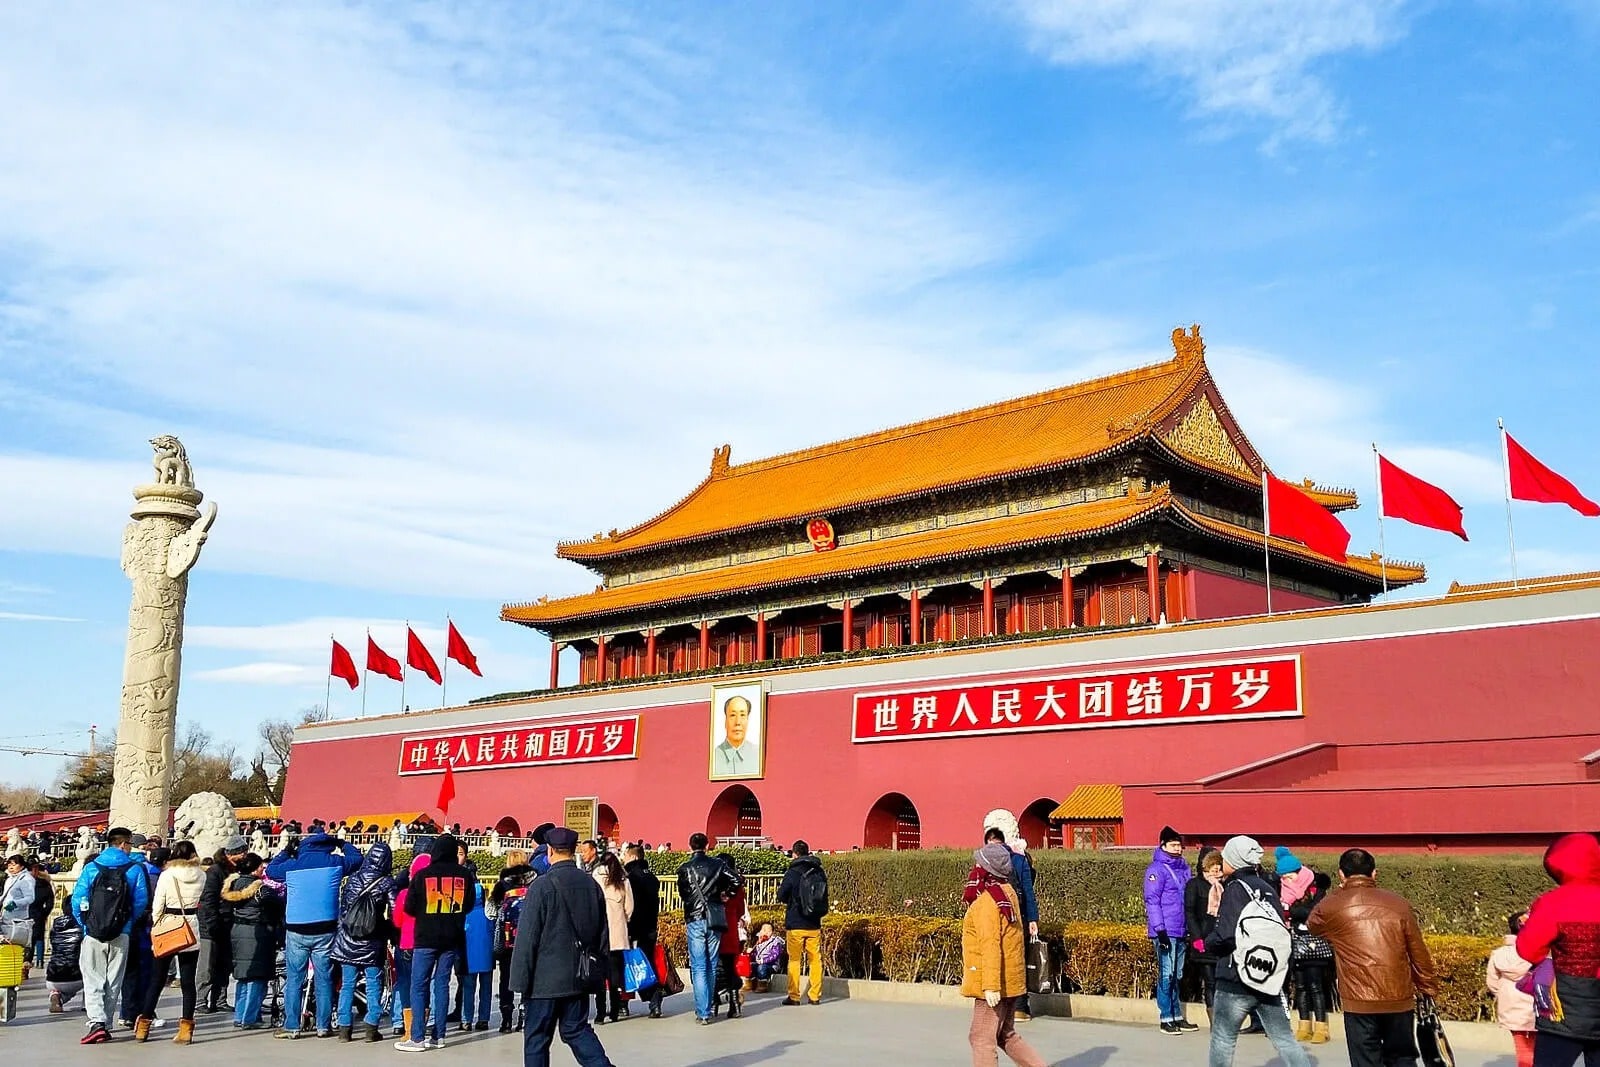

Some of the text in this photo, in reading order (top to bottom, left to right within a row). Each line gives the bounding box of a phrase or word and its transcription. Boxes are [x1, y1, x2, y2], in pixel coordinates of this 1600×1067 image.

[872, 668, 1271, 733] 世界人民大团结万岁
[410, 724, 624, 767] 中华人民共和国万岁
